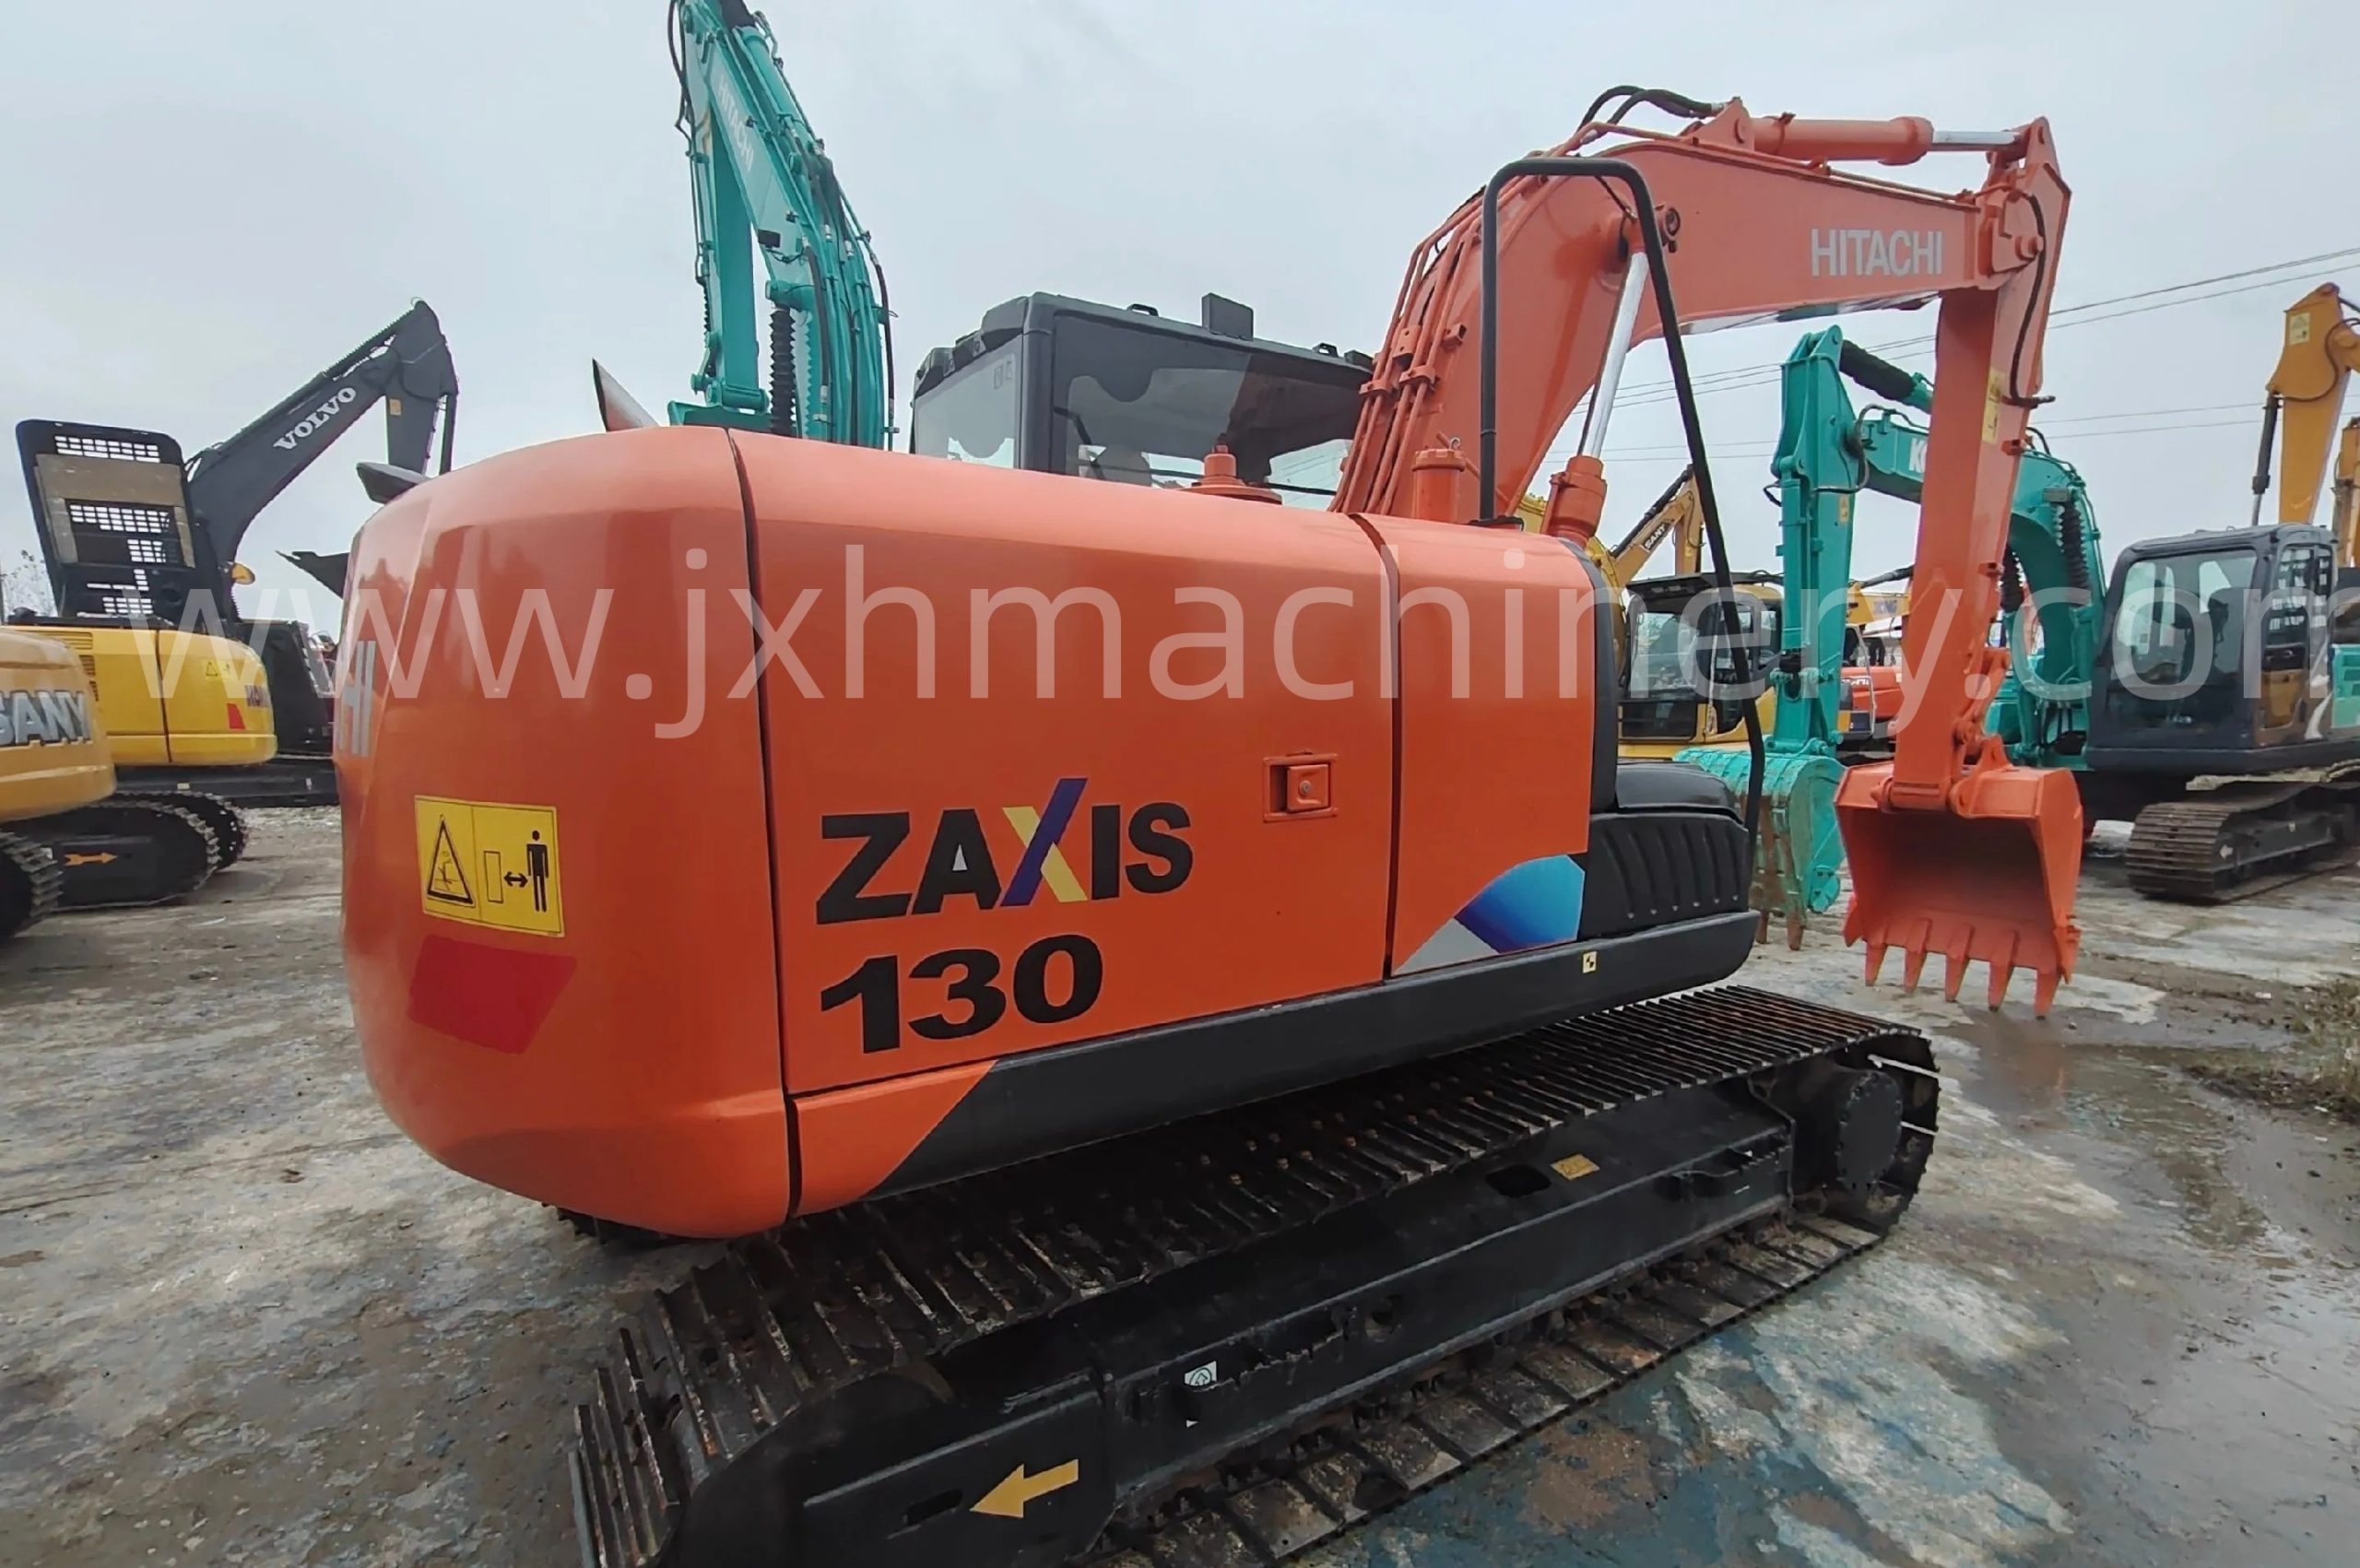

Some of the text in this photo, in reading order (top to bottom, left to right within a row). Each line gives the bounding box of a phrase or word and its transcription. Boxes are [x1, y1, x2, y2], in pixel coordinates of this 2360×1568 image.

[1811, 228, 1943, 277] HITACHI
[273, 387, 357, 450] VOLVO
[816, 778, 1194, 925] ZAXIS
[820, 935, 1103, 1054] 130
